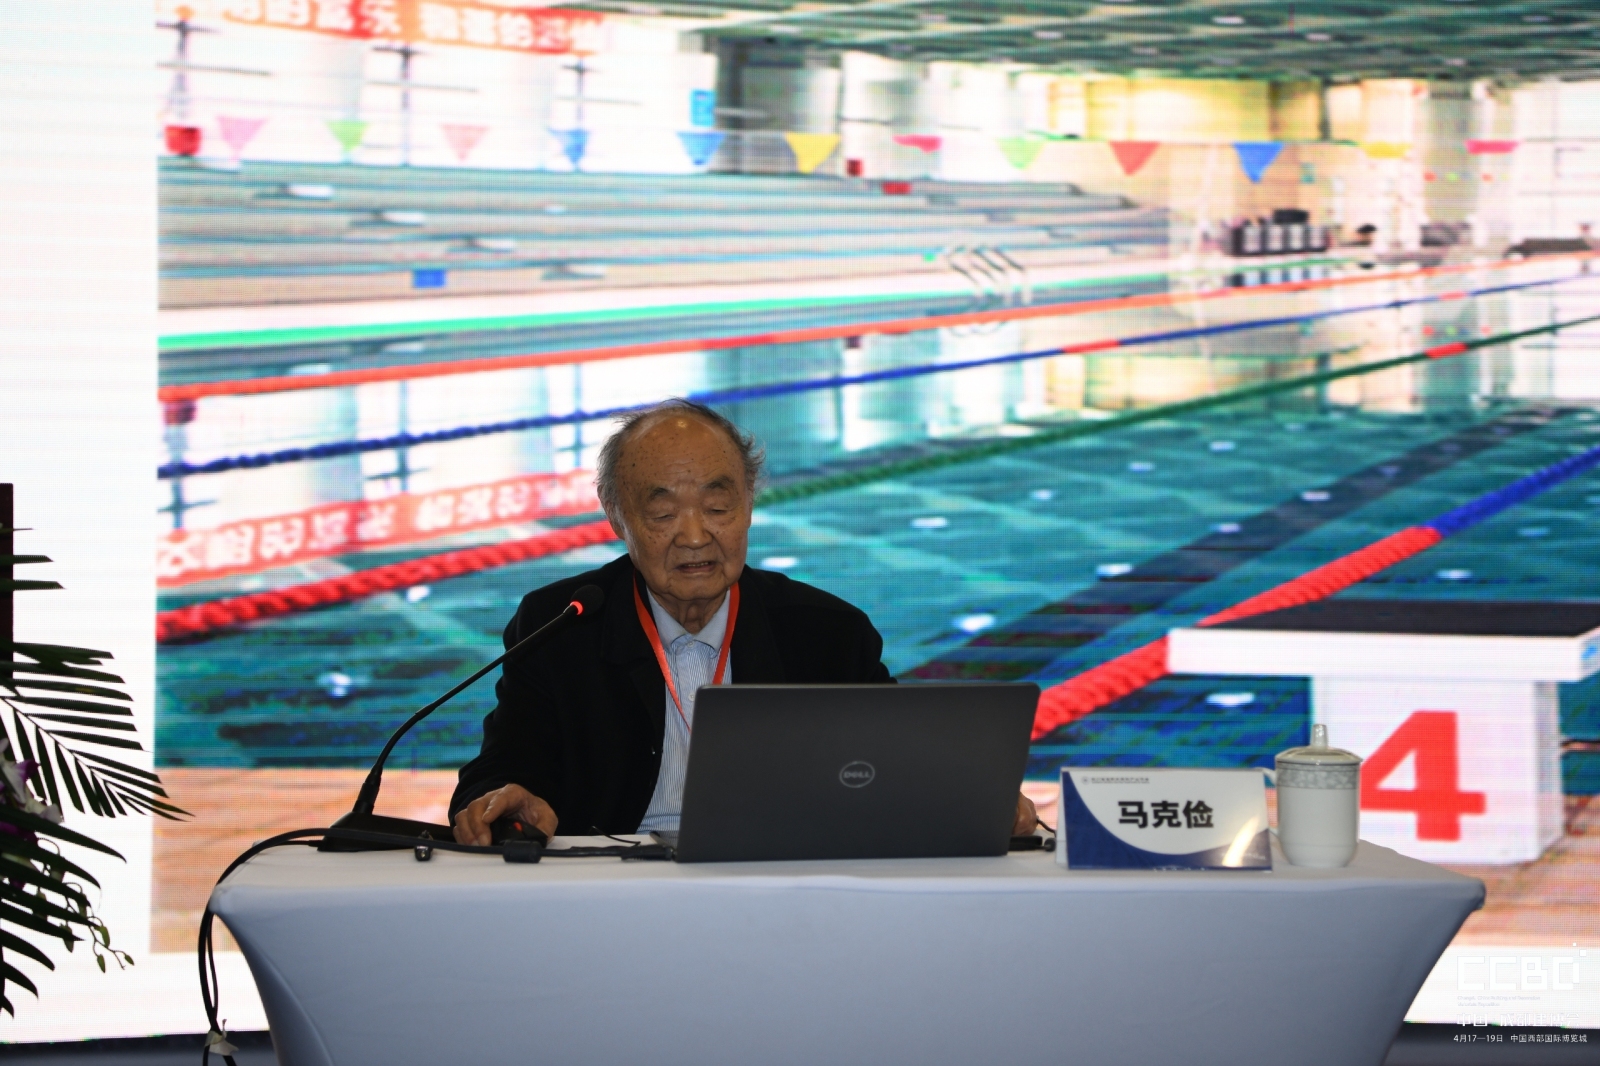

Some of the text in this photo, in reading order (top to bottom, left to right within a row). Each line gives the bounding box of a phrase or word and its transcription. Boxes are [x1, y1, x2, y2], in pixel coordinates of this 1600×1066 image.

[843, 771, 870, 779] DELL
[1361, 710, 1486, 841] 4
[1117, 800, 1214, 828] 马克俭
